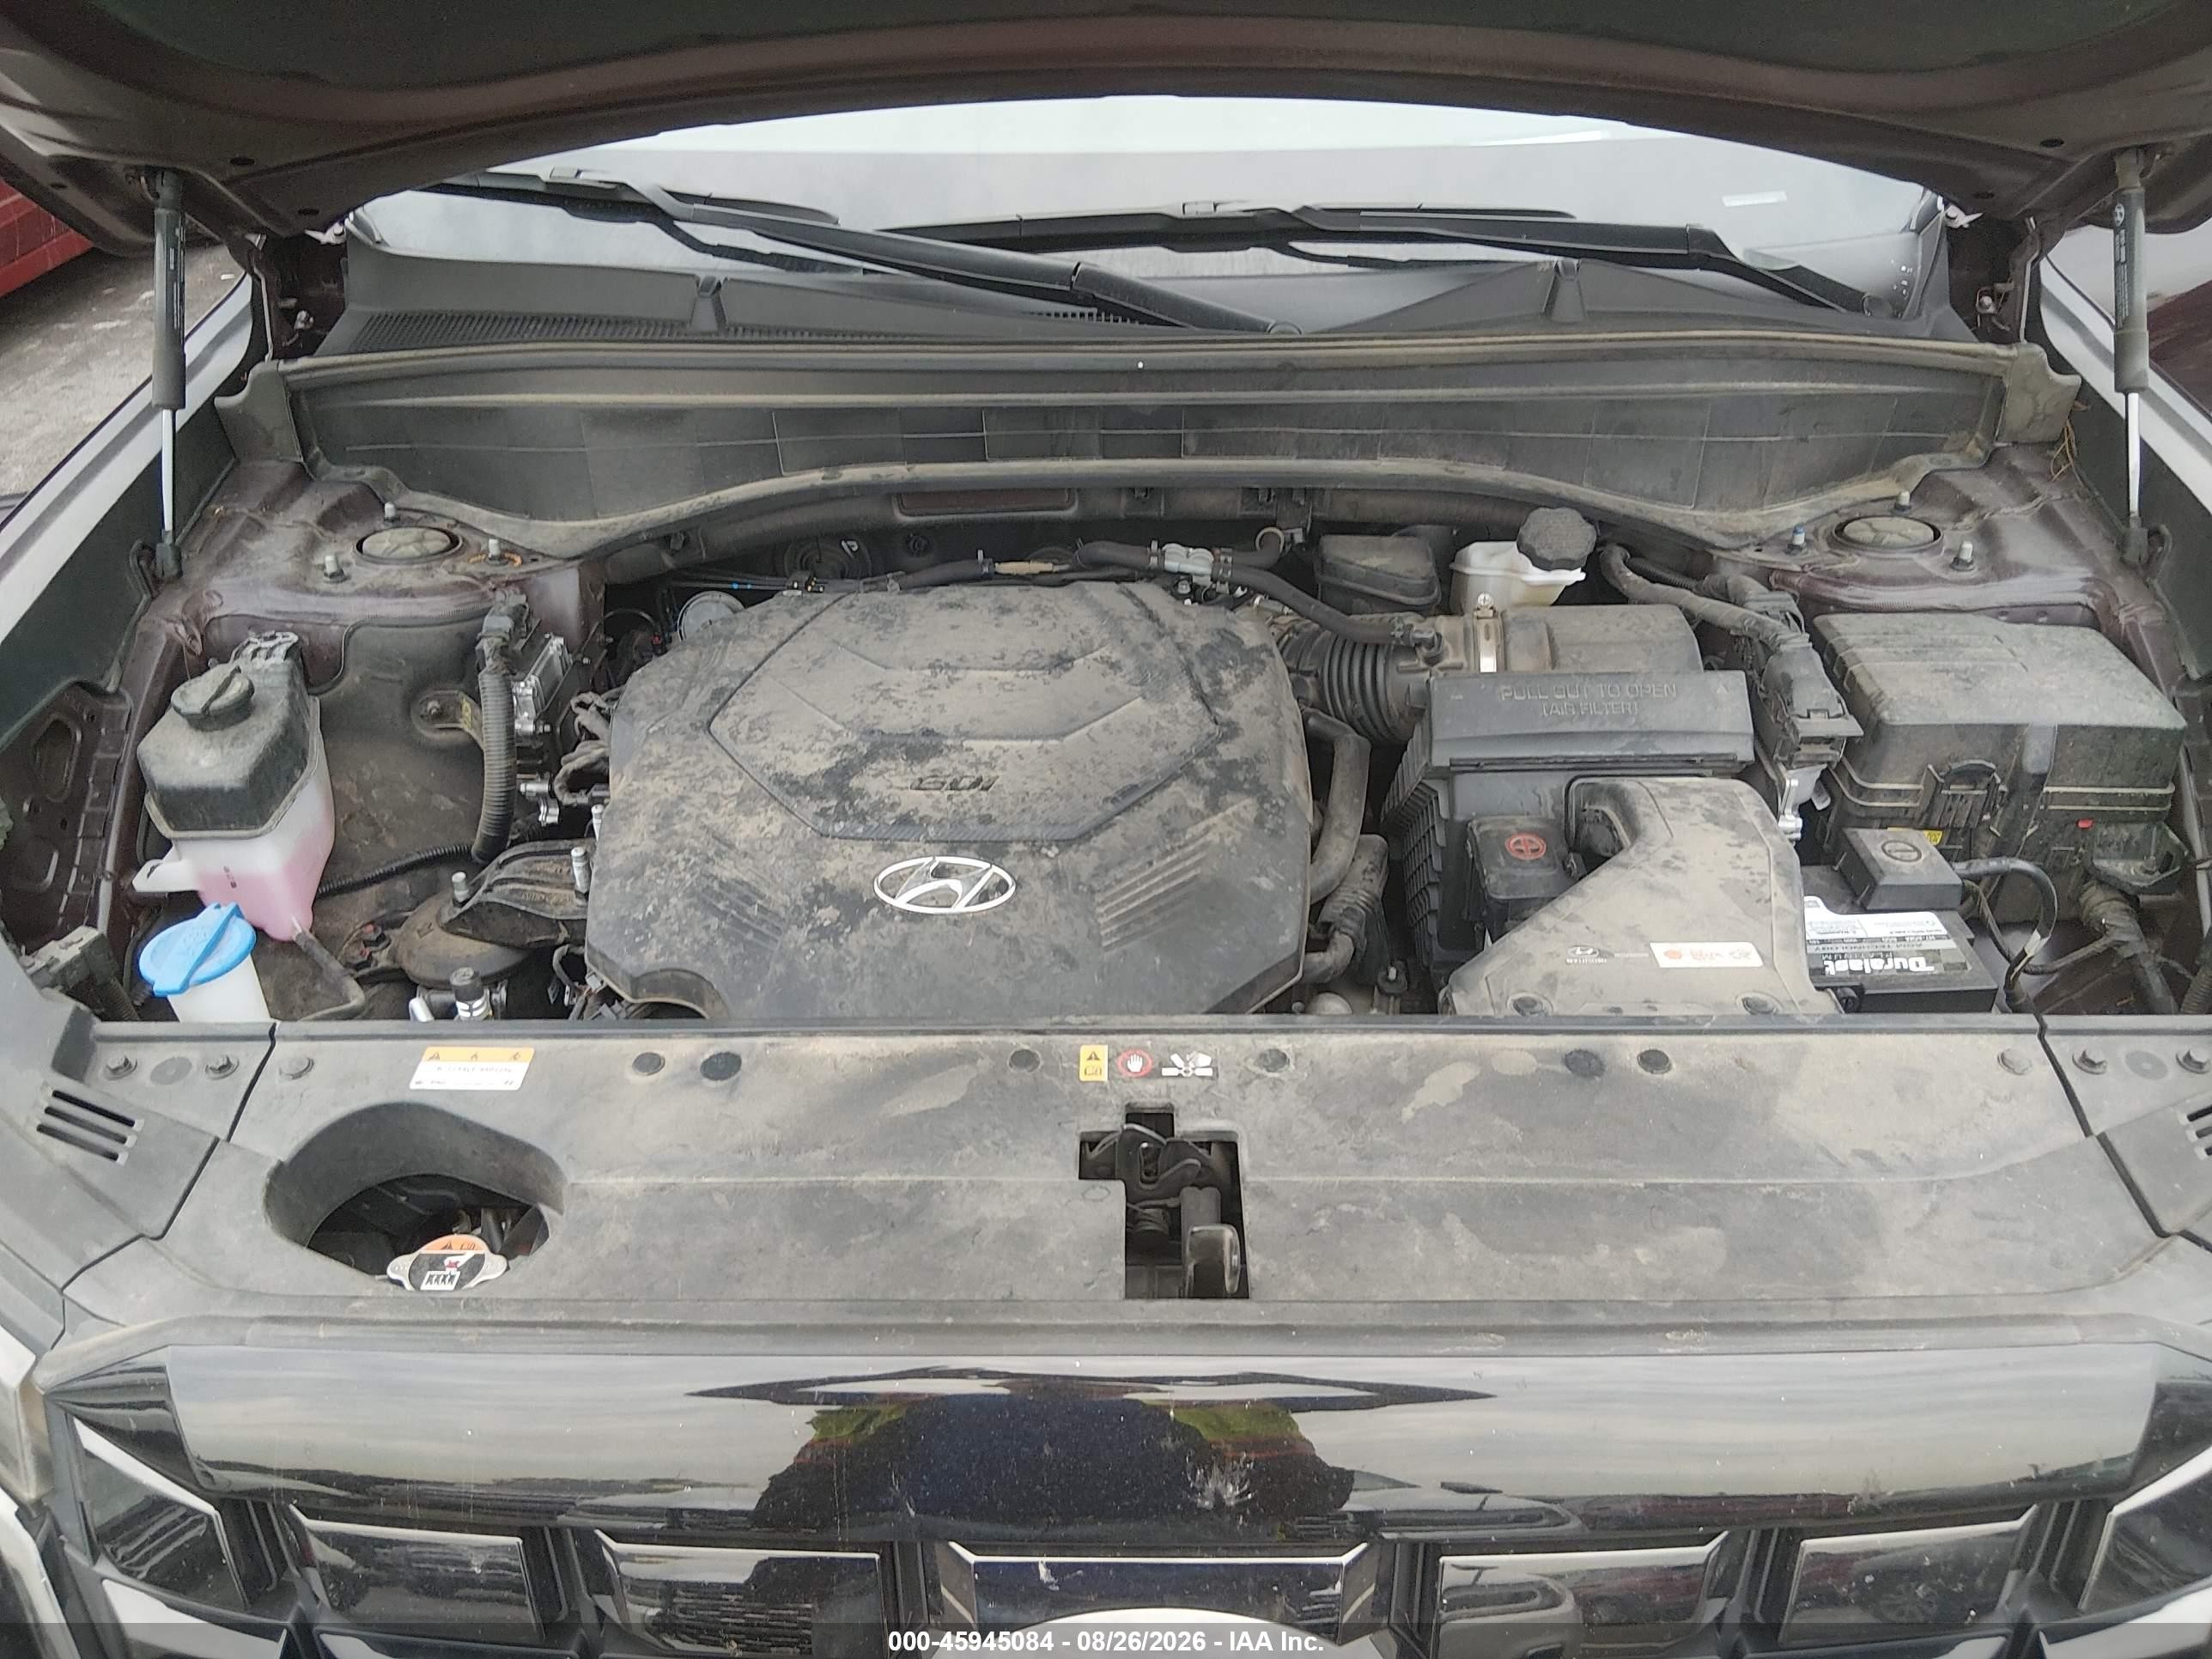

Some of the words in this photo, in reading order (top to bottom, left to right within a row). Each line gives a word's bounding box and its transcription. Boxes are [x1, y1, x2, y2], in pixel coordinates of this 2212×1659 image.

[1501, 685, 1548, 701] PULL
[1553, 684, 1588, 699] OUT
[1600, 684, 1620, 699] TO
[1627, 684, 1677, 698] OPEN
[1823, 957, 1935, 975] Duralast
